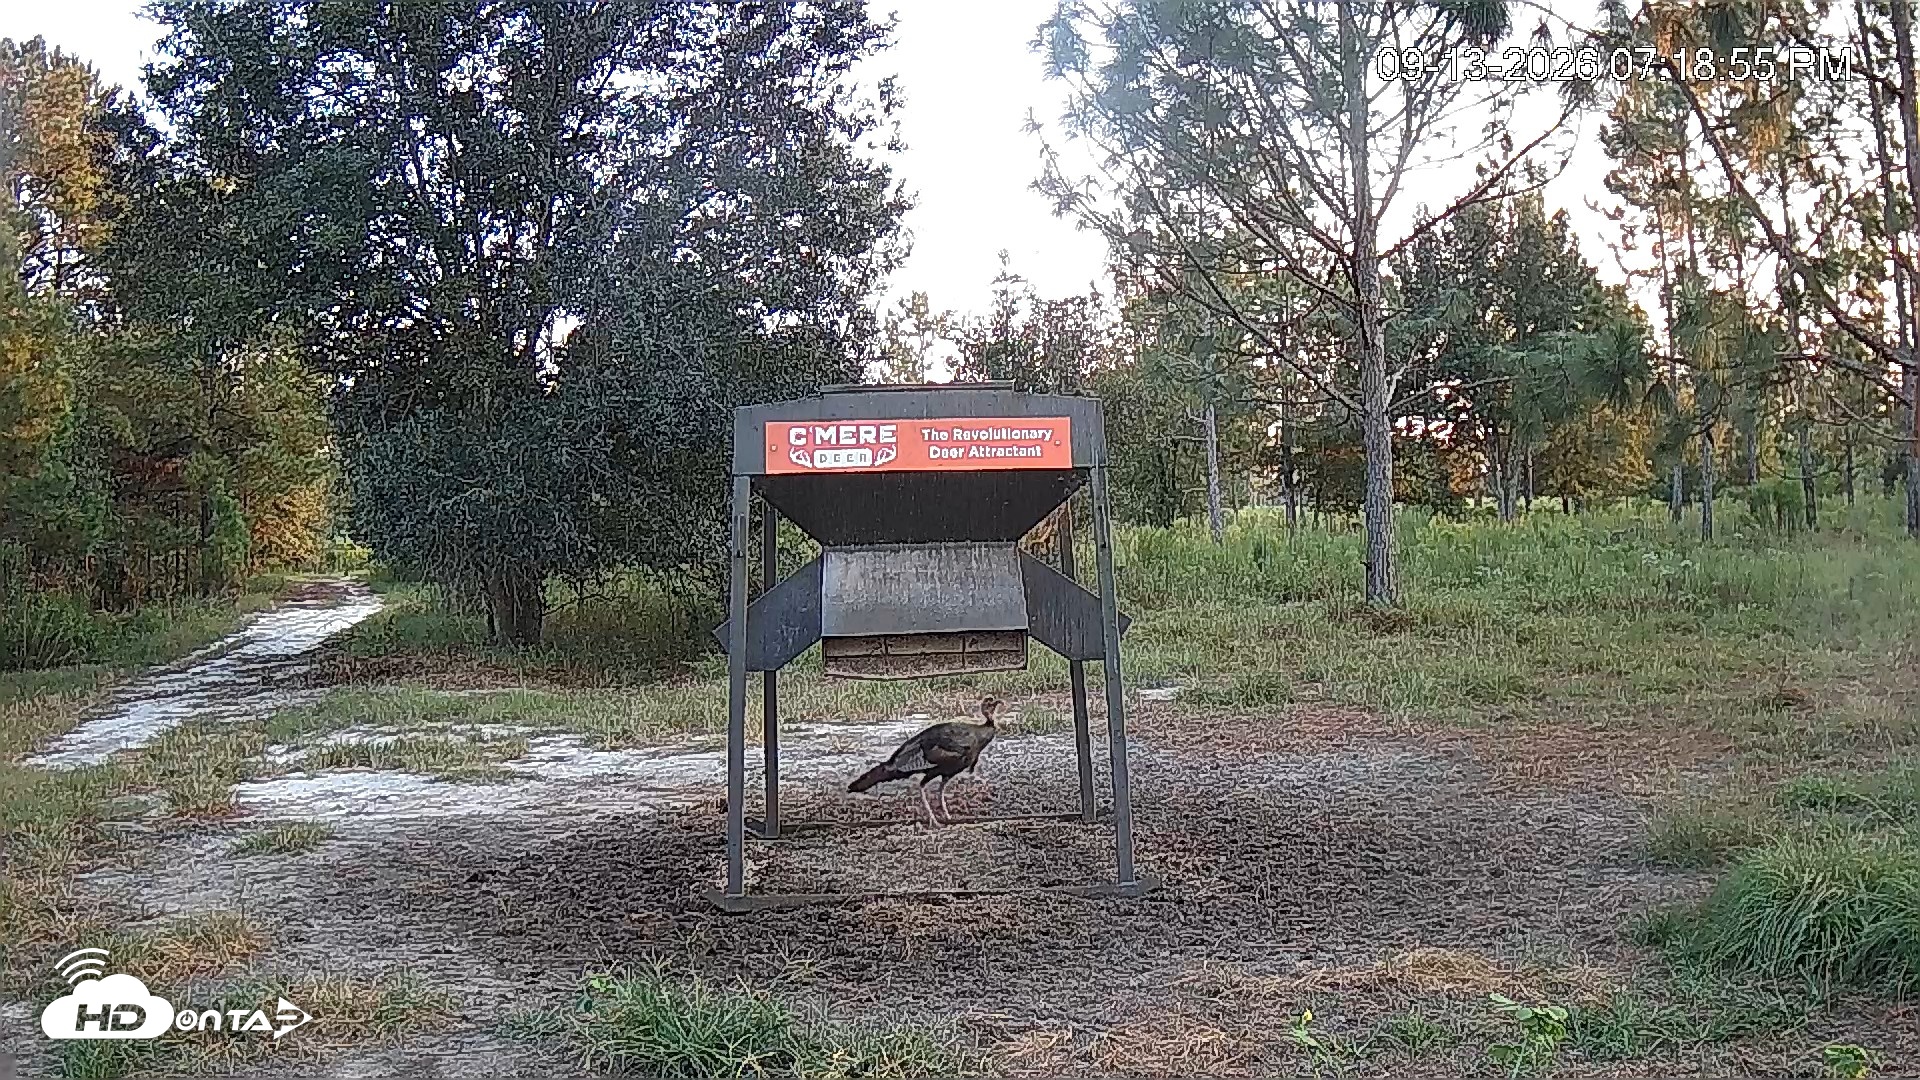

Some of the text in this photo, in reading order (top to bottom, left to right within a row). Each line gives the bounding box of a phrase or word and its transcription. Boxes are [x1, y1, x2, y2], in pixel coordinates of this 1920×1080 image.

[788, 424, 897, 446] C'MERE
[920, 427, 1054, 442] The Revolutionary
[928, 444, 1043, 459] Deer Attractant
